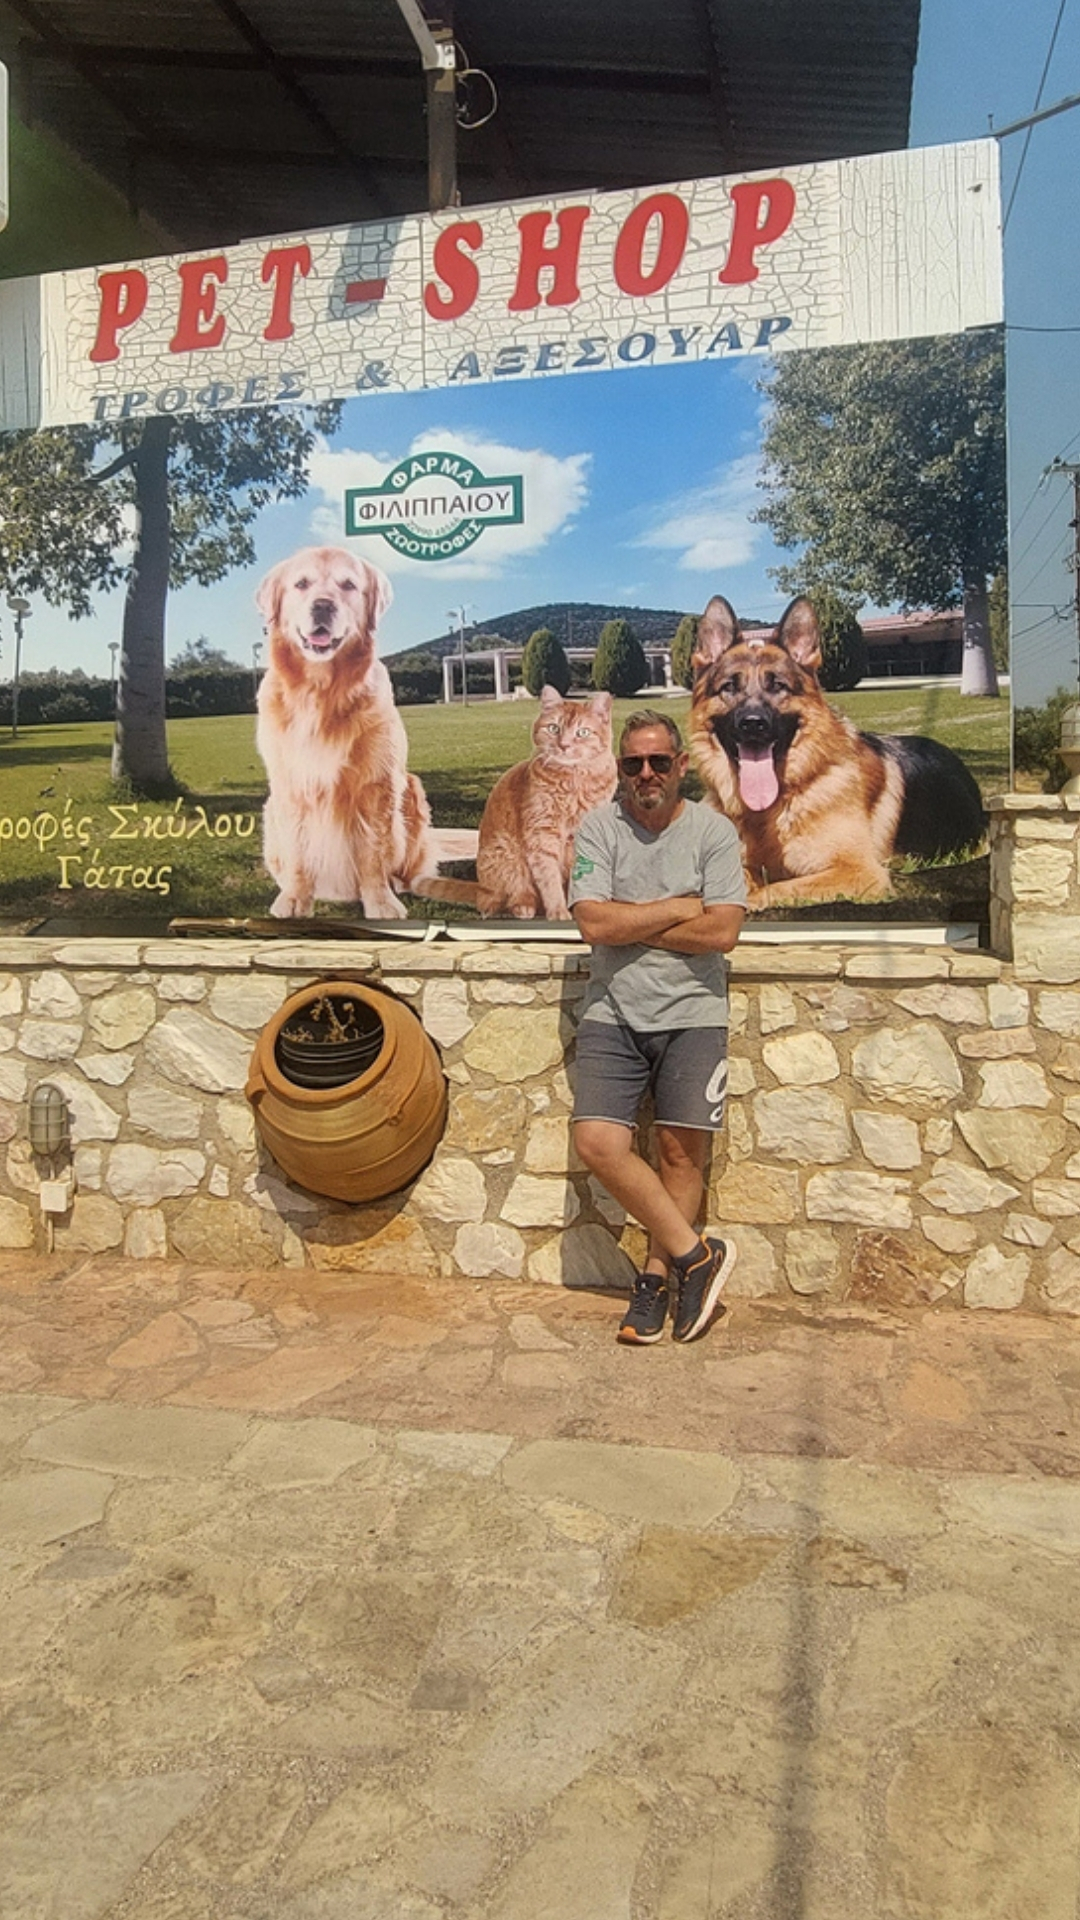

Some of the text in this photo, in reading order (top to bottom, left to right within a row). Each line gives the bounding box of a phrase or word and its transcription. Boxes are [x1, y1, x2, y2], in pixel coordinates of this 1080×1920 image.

[90, 316, 794, 421] ΤΡΟΦΕΣ & ΑΞΕΣΟΥΑΡ
[359, 491, 510, 520] ΦΙΛΙΠΠΑΙΟΥ
[385, 519, 483, 556] ΖΩΟΤΡΟΦΕΣ
[0, 797, 256, 852] ροφές Σκύλου
[56, 848, 172, 895] Γάτας
